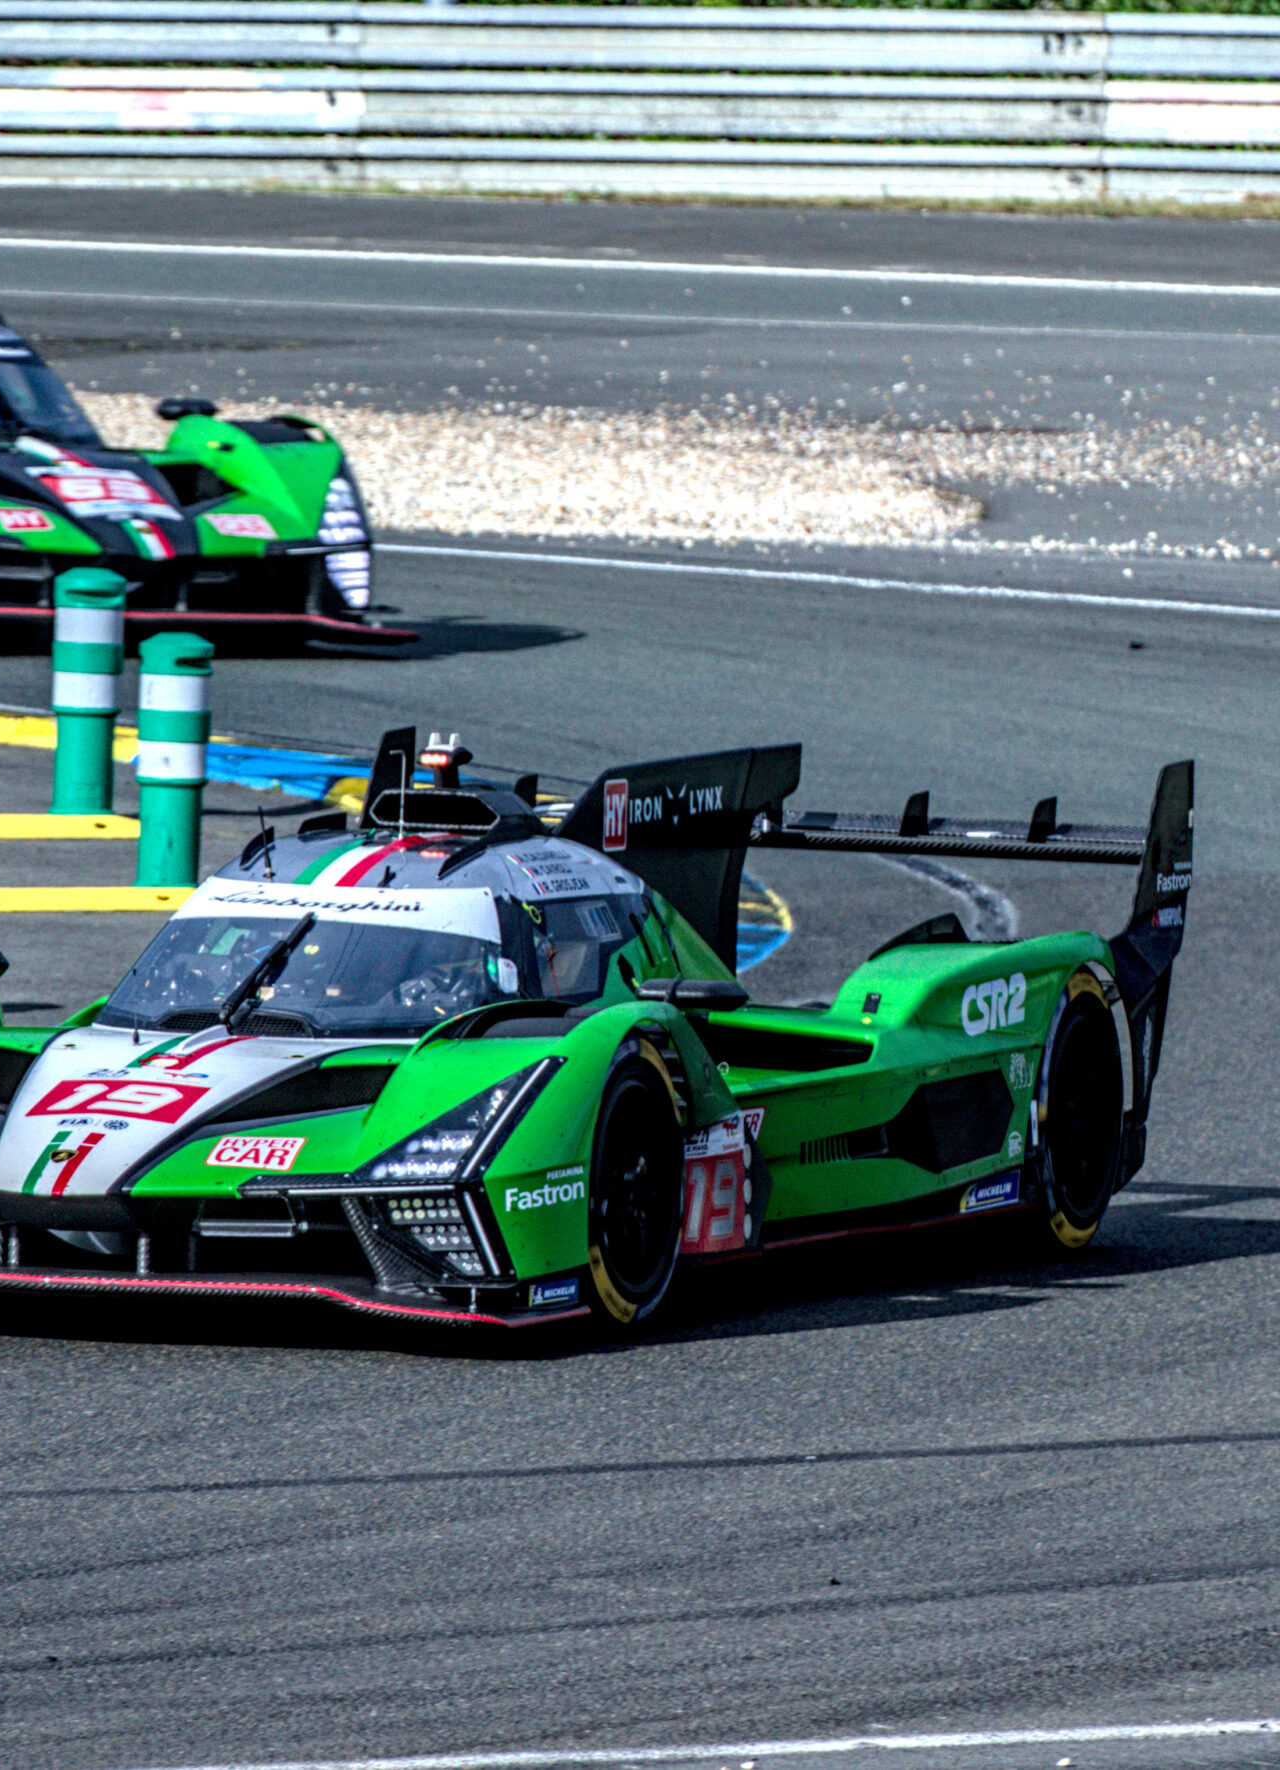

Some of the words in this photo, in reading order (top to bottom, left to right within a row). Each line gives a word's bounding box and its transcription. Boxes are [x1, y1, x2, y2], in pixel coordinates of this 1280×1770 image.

[605, 793, 626, 838] HY
[628, 795, 663, 824] IRON
[689, 784, 723, 816] LYNX
[1156, 872, 1192, 893] Fastron
[209, 889, 425, 913] Lamborghini
[961, 972, 1027, 1037] CSR2
[45, 1082, 184, 1115] 19
[222, 1138, 298, 1149] HYPER
[214, 1146, 291, 1166] CAR
[546, 1165, 584, 1181] PERTAMINA
[504, 1180, 585, 1213] Fastron
[684, 1159, 738, 1243] 19
[976, 1181, 1013, 1200] MICHELIN
[543, 1284, 576, 1299] MICHELIN
